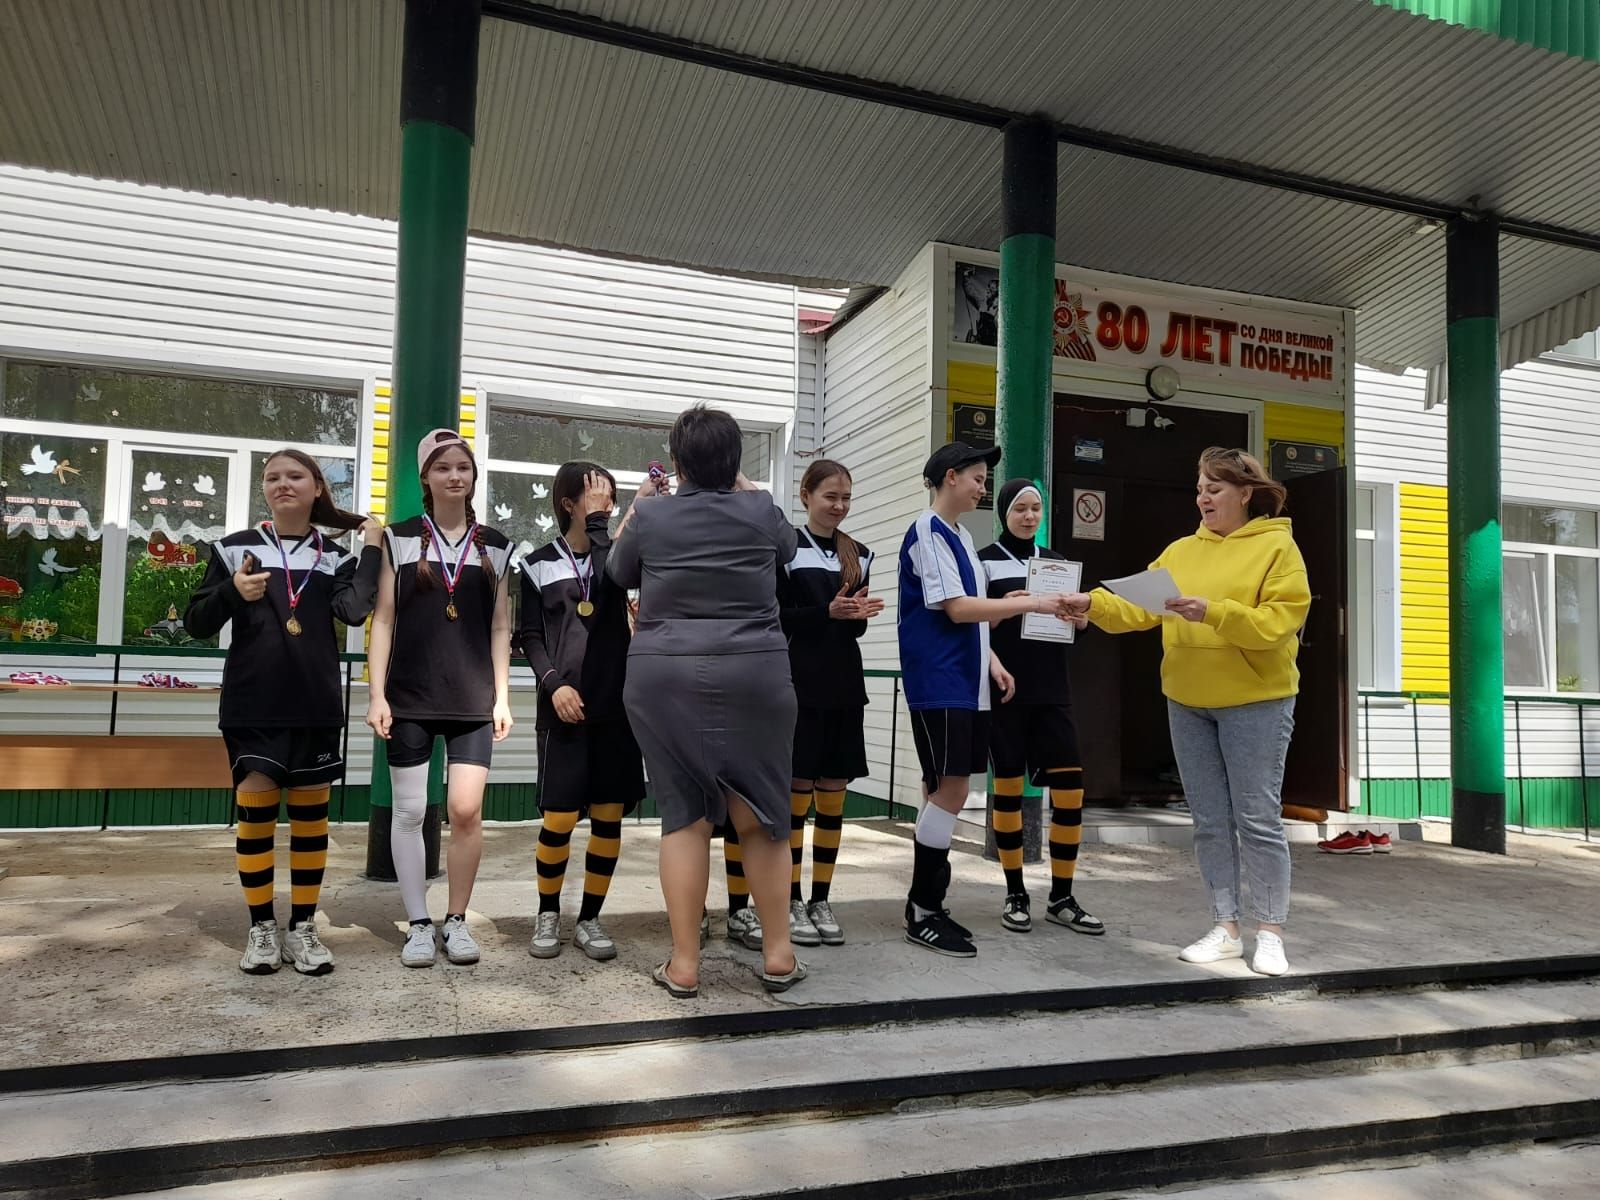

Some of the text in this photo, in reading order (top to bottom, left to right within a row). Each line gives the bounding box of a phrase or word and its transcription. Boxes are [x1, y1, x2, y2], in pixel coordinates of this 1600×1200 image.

[1096, 301, 1150, 354] 80
[1160, 311, 1238, 367] ЛЕТ
[1240, 324, 1333, 352] СО ДНЯ ВЕЛИКОЙ
[1240, 343, 1333, 381] ПОБЕДЫ!
